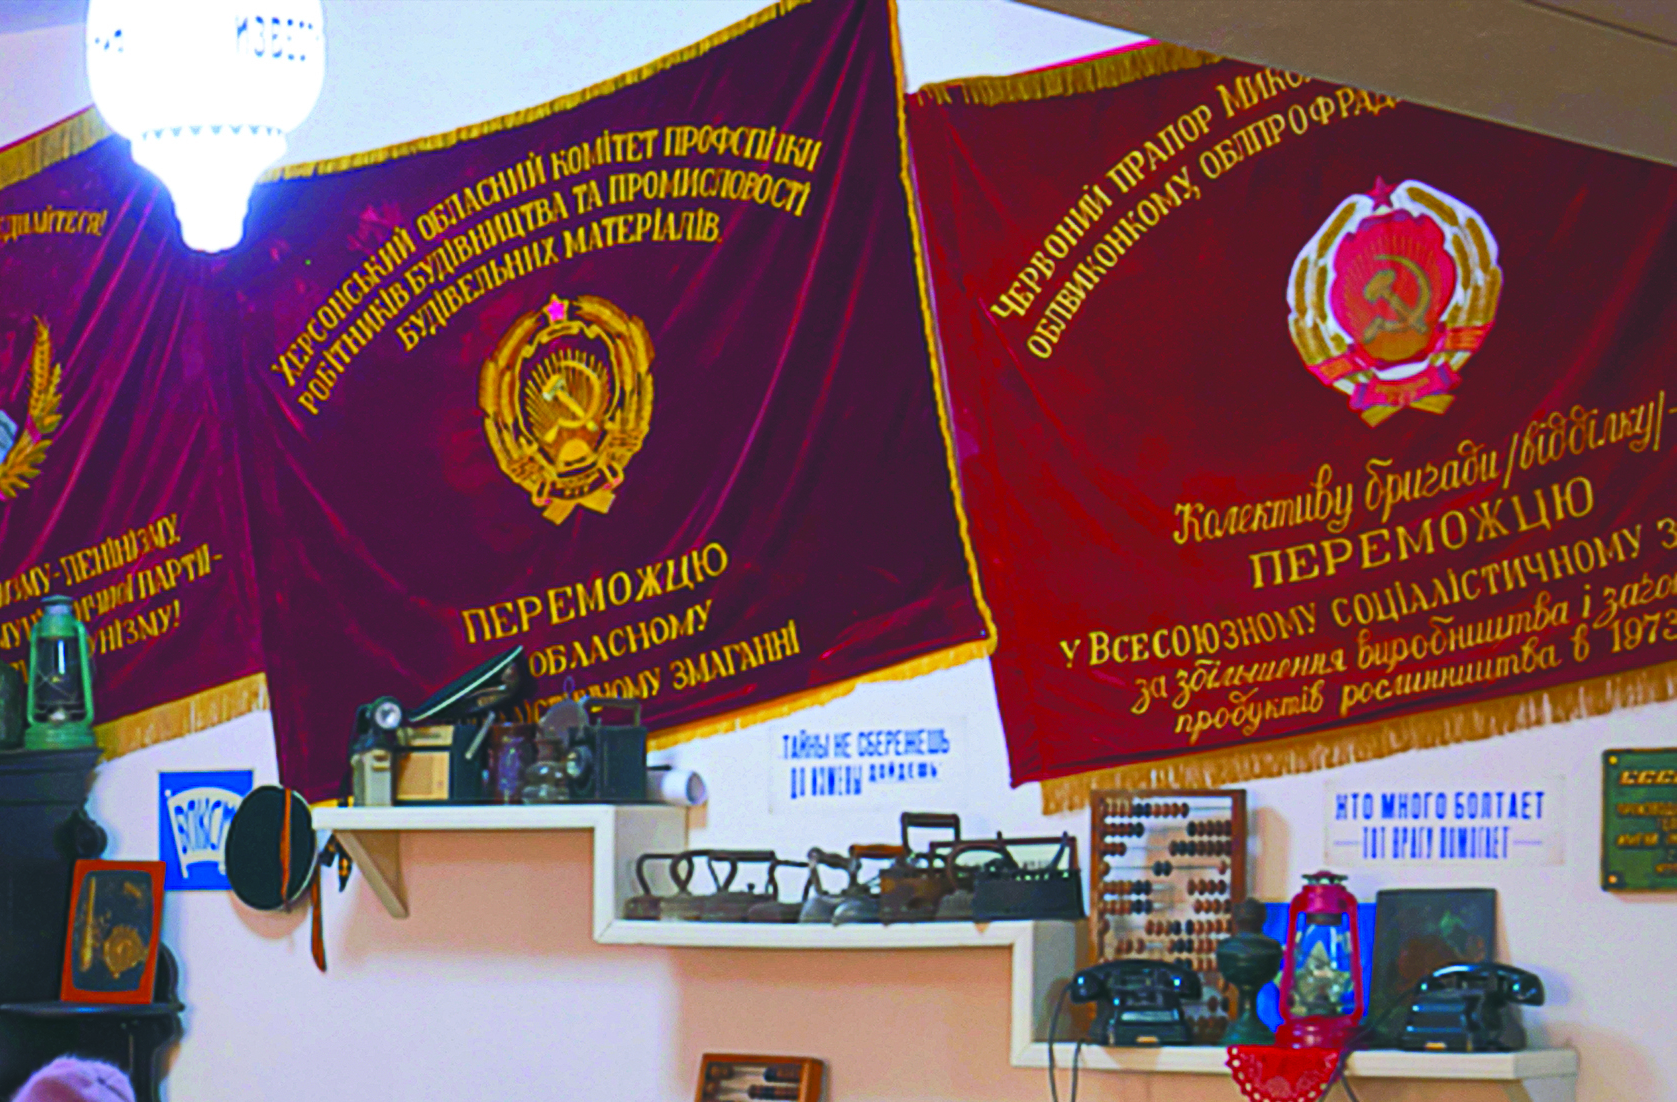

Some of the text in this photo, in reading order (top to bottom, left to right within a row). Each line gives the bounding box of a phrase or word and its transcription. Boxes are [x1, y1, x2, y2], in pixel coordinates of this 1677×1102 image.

[990, 67, 1311, 320] ЧЕРВОНИЙ ПРАПОР МИКО
[272, 225, 416, 387] ХЕРСОНСЬКИЙ
[416, 151, 547, 241] ОБЛАСНИЙ
[551, 129, 659, 181] КОМІТЕТ
[298, 168, 811, 415] РОБІТНИКІВ БУДІВНИЦТВА ТА ПРОМИСЛОВОСТІ
[395, 207, 720, 352] БУДІВЕЛЬНИХ МАТЕРІАЛІВ
[1026, 166, 1202, 359] ОБЛВИКОНКОМУ,
[1173, 463, 1353, 545] Колективу
[1248, 476, 1594, 588] ПЕРЕМОЖЦЮ
[461, 542, 729, 644] ПЕРЕМОЖЦЮ
[1331, 524, 1642, 628] СОЦІАЛІСТИЧНОМУ
[529, 599, 712, 678] ОБЛАСНОМУ
[669, 619, 801, 690] ЗМАГАННІ
[1130, 573, 1677, 715] за збільшення виробництва і заго
[1175, 680, 1325, 745] продуктів
[1340, 636, 1563, 717] рослинництва
[1570, 623, 1591, 662] в
[834, 732, 852, 759] НЕ
[1335, 791, 1545, 820] КТО МНОГО БОЛТАЕТ
